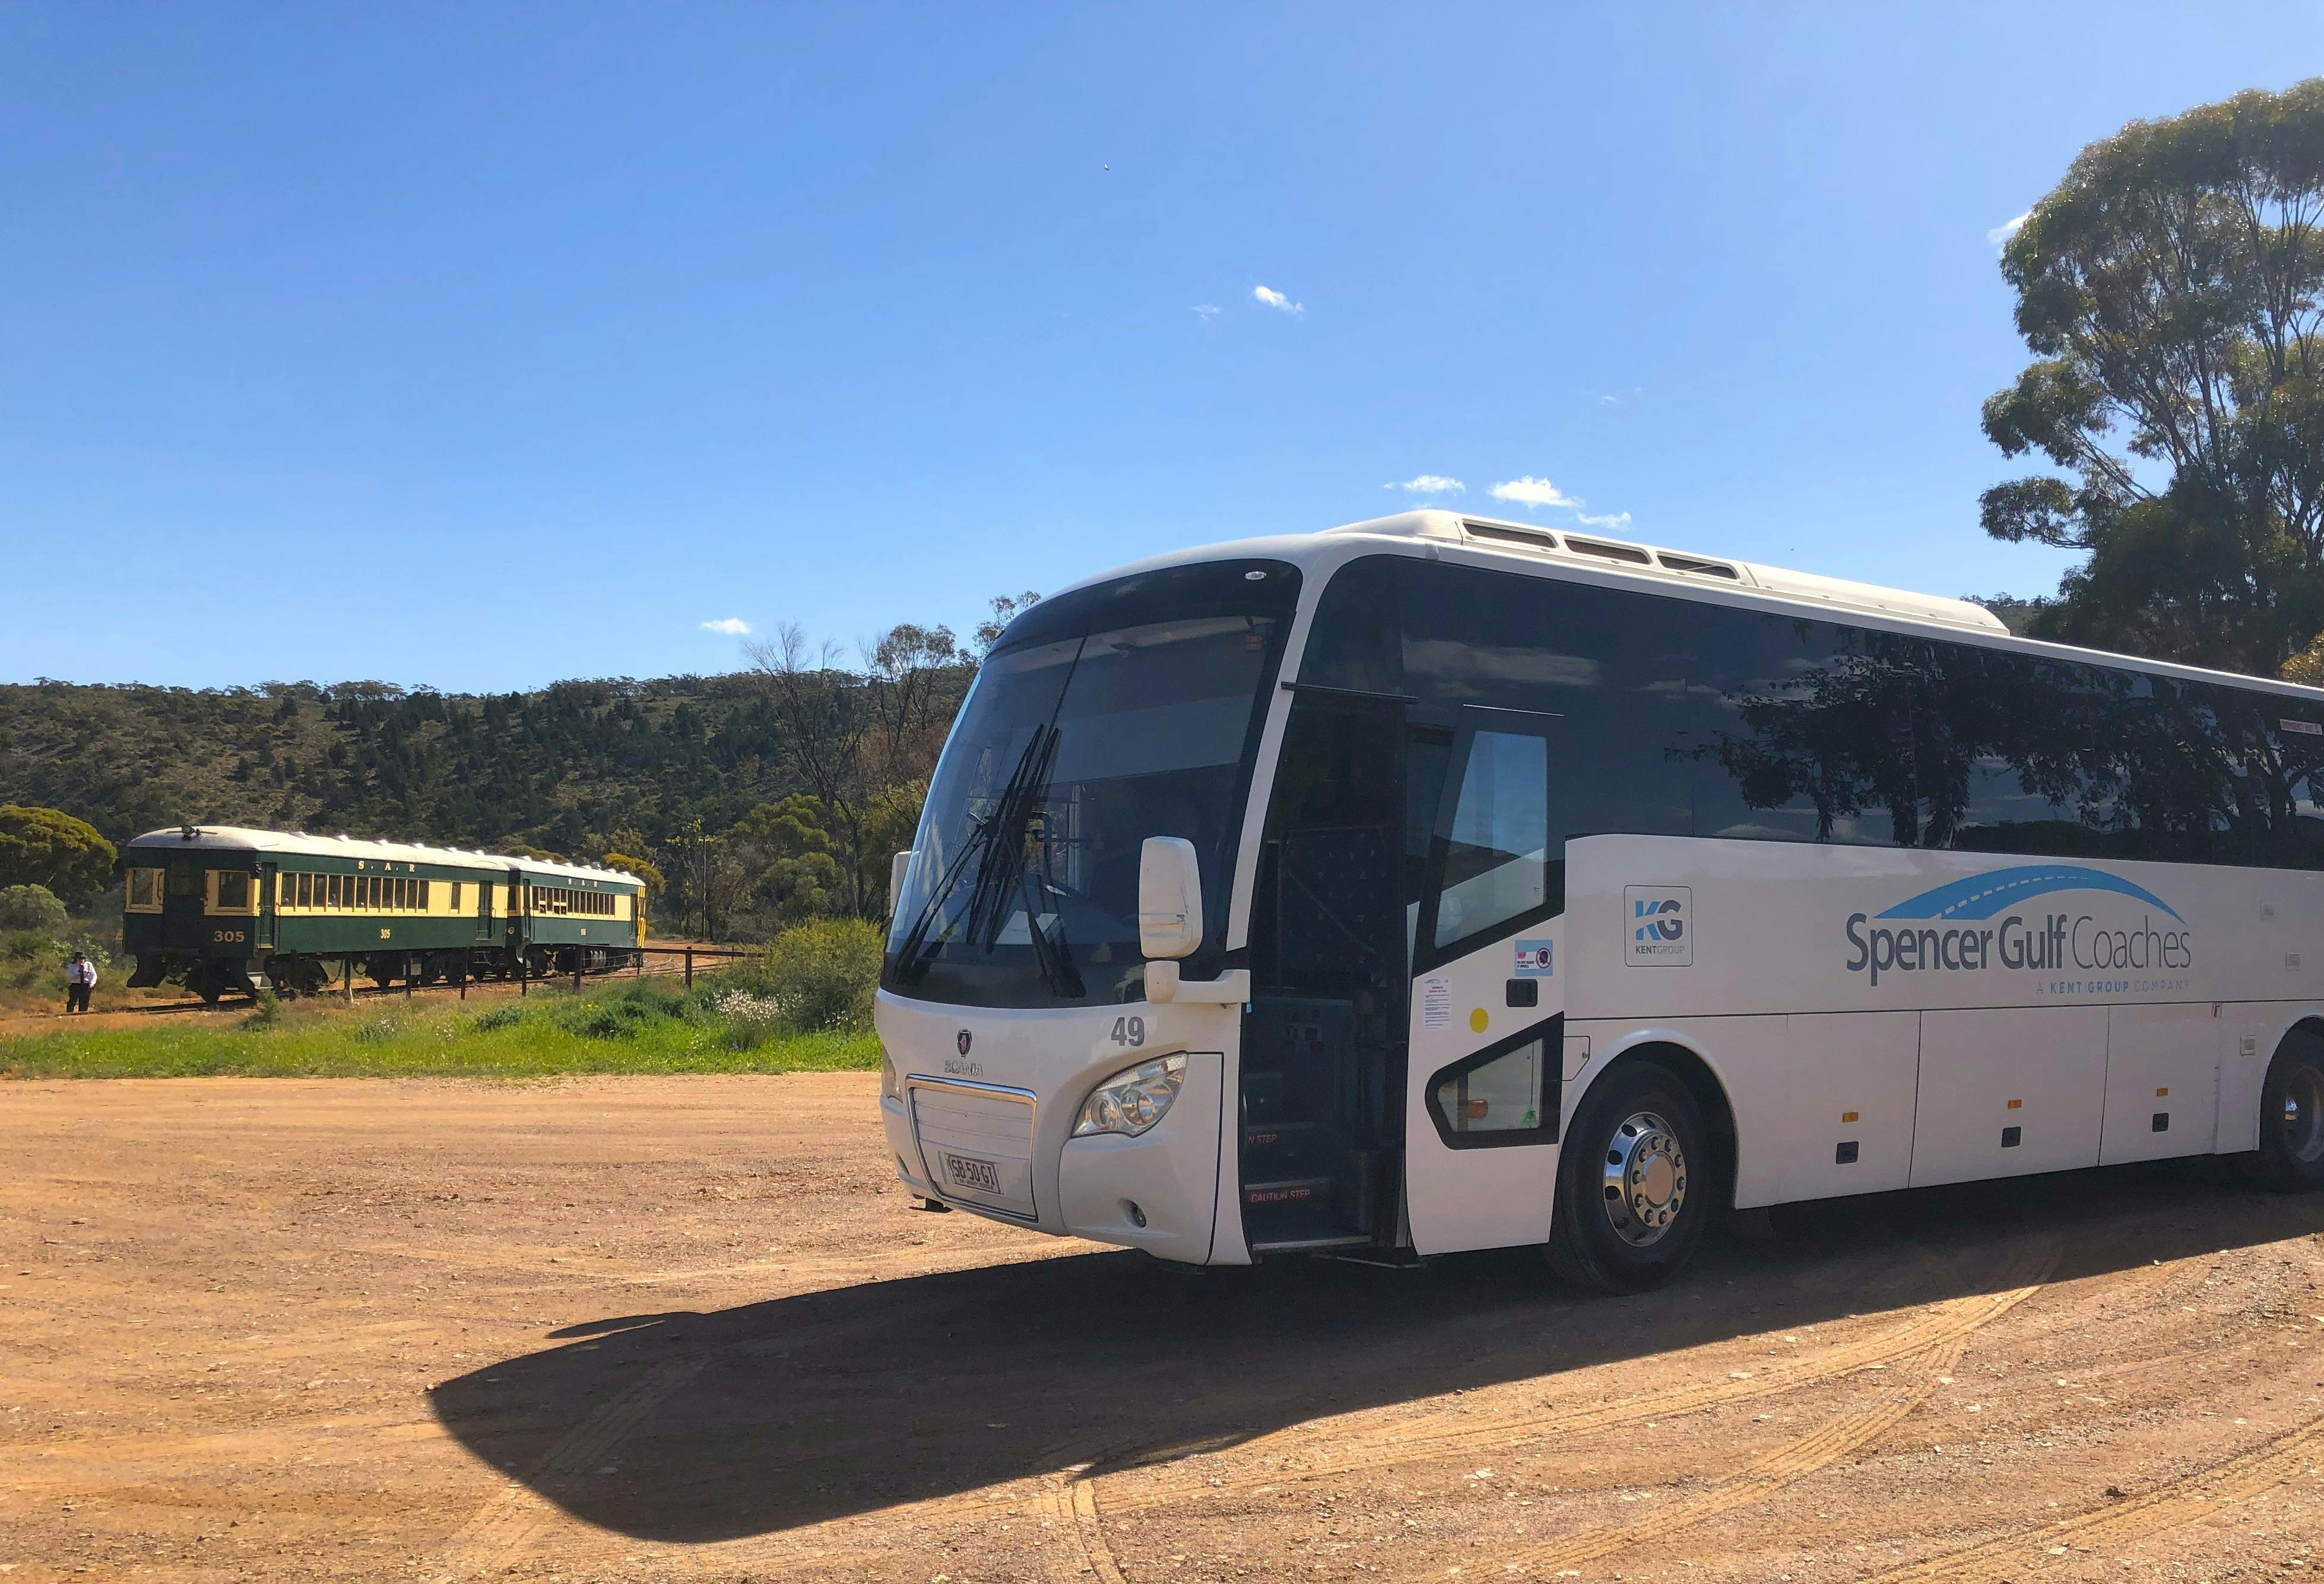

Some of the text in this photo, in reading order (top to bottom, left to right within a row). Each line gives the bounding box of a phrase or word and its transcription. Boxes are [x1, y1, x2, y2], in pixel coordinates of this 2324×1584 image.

[1635, 900, 1683, 941] KG
[214, 931, 245, 942] 305
[380, 929, 391, 939] 305
[1846, 913, 2192, 986] Spencer Gulf Coaches
[2037, 979, 2190, 994] A KENT GROUP COMPANY
[1111, 1017, 1144, 1046] 49
[944, 1060, 984, 1077] SCANIA
[1251, 1189, 1310, 1202] CAUTION STEP
